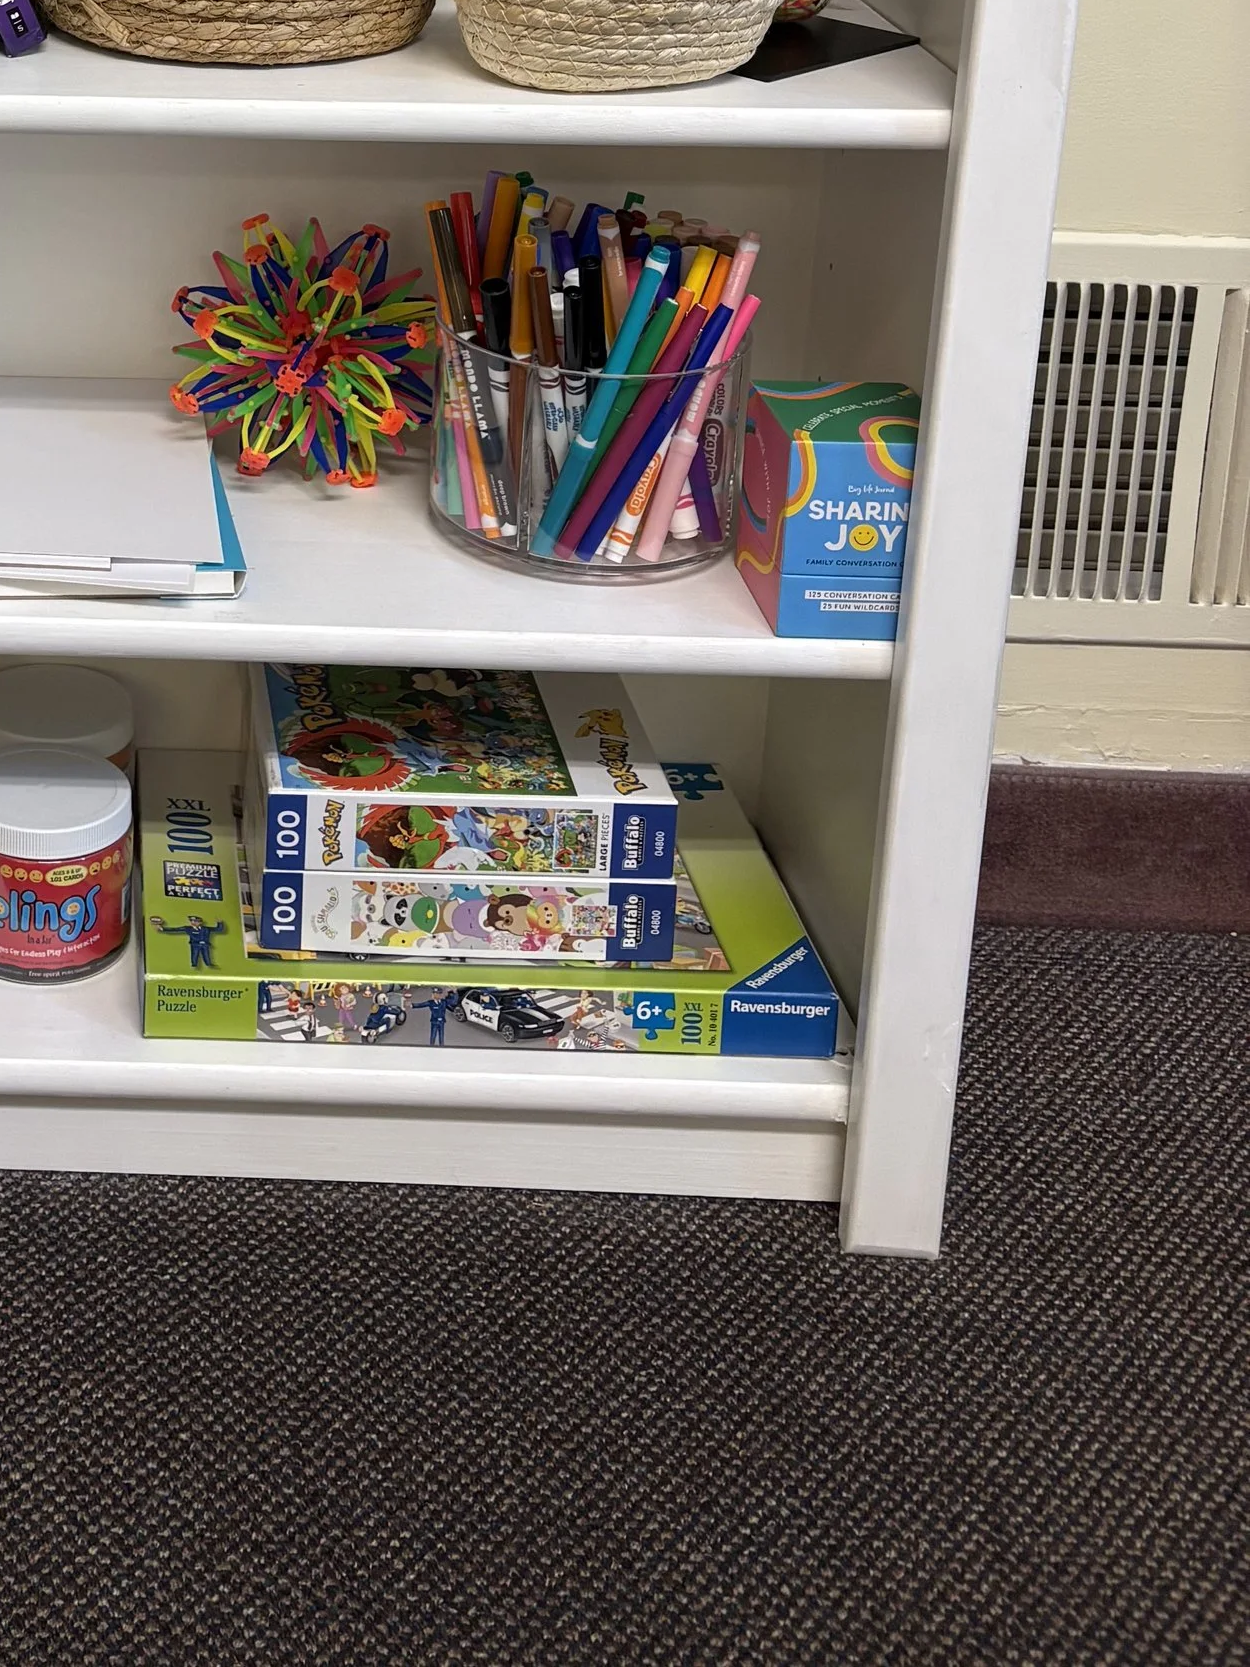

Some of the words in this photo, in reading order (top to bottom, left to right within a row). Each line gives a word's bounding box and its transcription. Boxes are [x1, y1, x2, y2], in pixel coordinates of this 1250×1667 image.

[808, 499, 910, 522] SHARIN
[824, 523, 904, 553] JOY
[805, 558, 834, 566] FAMILY
[835, 559, 897, 567] CONVERSATION
[822, 602, 832, 610] 25
[834, 602, 851, 610] FUN
[823, 591, 888, 600] CONVERSATION
[166, 797, 211, 812] XXL
[165, 812, 214, 855] 100
[275, 809, 301, 859] 100
[599, 815, 609, 844] PIECES
[621, 815, 640, 871] Buffalo
[655, 830, 665, 858] 04800
[166, 862, 218, 872] PREMIUM
[598, 844, 609, 872] LARGE
[166, 867, 219, 879] PUZZLE
[167, 884, 220, 895] PERFECT
[272, 885, 297, 935] 100
[620, 894, 640, 950] Buffalo
[650, 909, 661, 936] 04800
[745, 945, 809, 990] Ravensburger
[156, 984, 242, 1001] Ravensburger
[156, 999, 197, 1013] Puzzle
[634, 1000, 663, 1021] 6+
[683, 1002, 704, 1012] XXL
[730, 999, 831, 1018] Ravensburger
[469, 1009, 494, 1026] POLICE
[681, 1012, 704, 1046] 100
